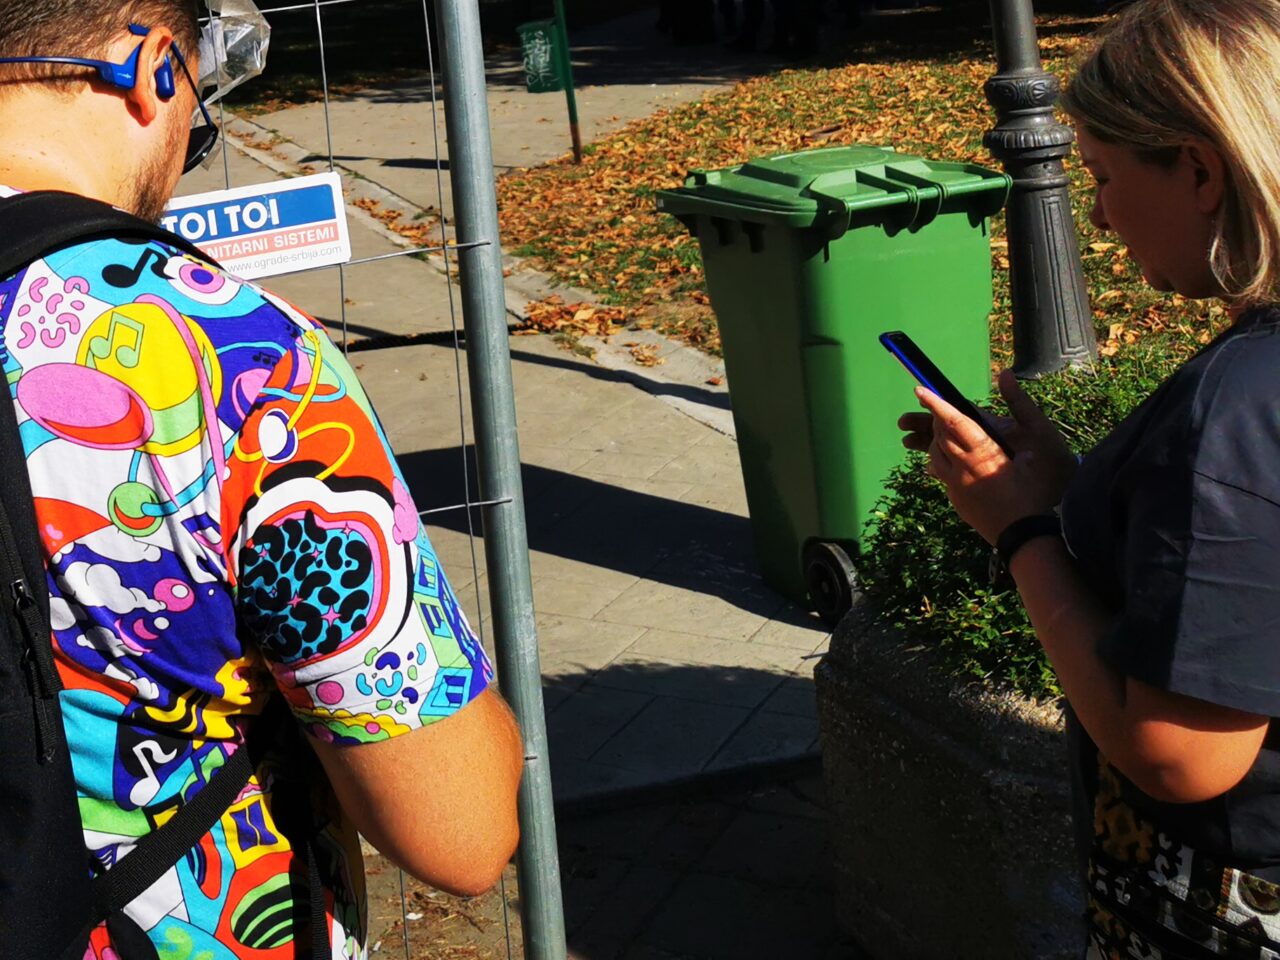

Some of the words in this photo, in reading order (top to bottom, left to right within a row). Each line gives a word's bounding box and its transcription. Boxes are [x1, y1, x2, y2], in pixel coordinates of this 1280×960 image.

[224, 199, 280, 232] TOI
[274, 226, 335, 248] SISTEMI
[226, 245, 342, 273] www.ograde-srbija.com
